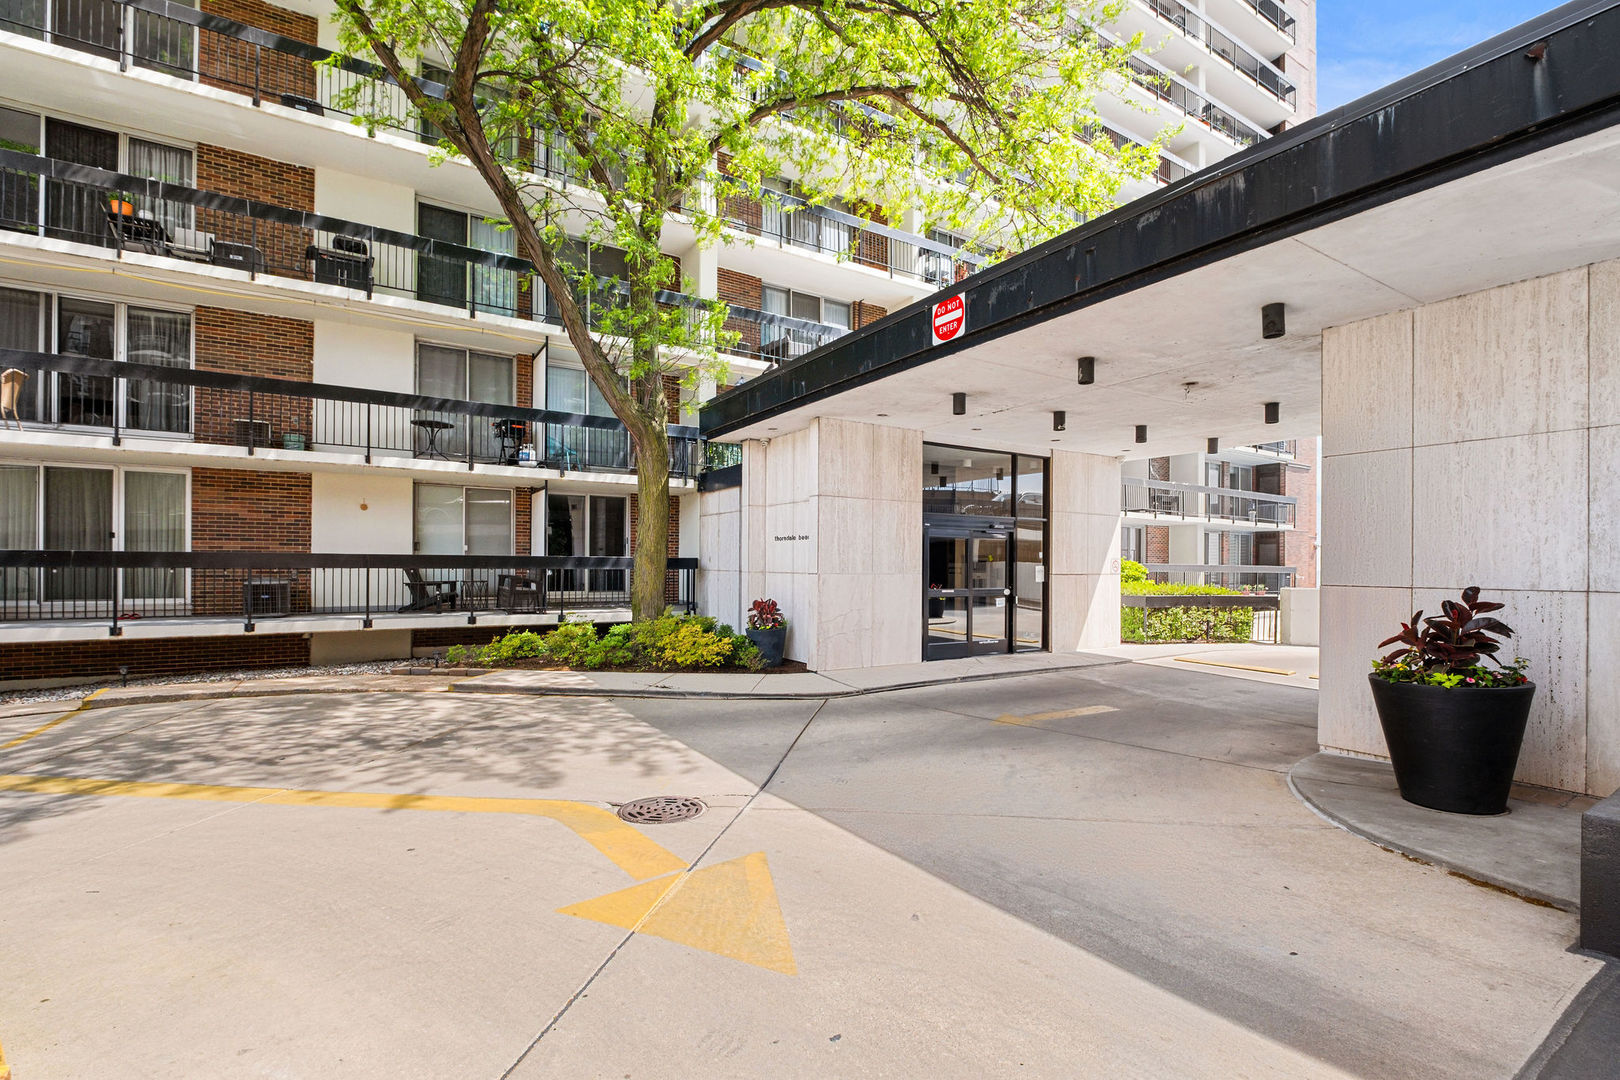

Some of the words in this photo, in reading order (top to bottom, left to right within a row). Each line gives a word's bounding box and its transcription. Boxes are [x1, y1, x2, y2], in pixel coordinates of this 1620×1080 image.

[937, 306, 946, 315] DO
[947, 300, 960, 311] NOT
[939, 321, 958, 334] ENTER
